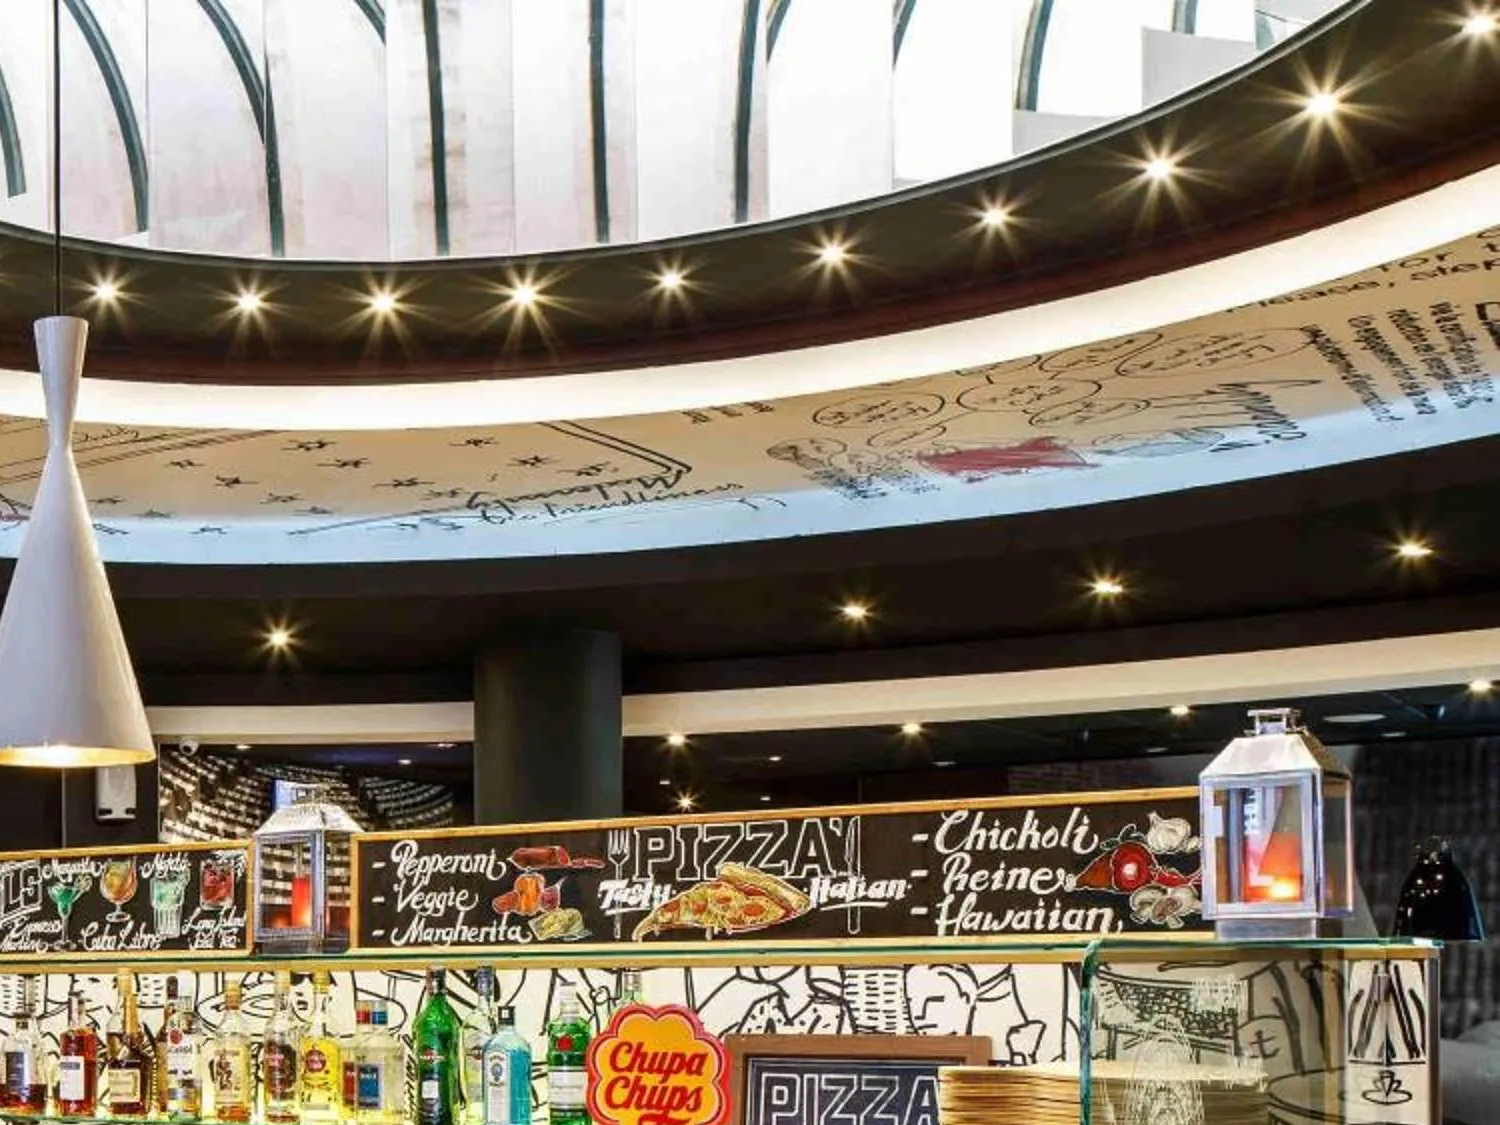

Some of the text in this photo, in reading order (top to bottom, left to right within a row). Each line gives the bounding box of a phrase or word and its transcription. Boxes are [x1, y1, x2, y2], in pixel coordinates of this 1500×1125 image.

[391, 839, 507, 886] Pepperoni
[393, 878, 479, 917] Veggie
[599, 877, 673, 911] Tasty
[809, 875, 907, 910] Italian
[390, 911, 533, 946] Margherita
[609, 1041, 708, 1084] Chupa
